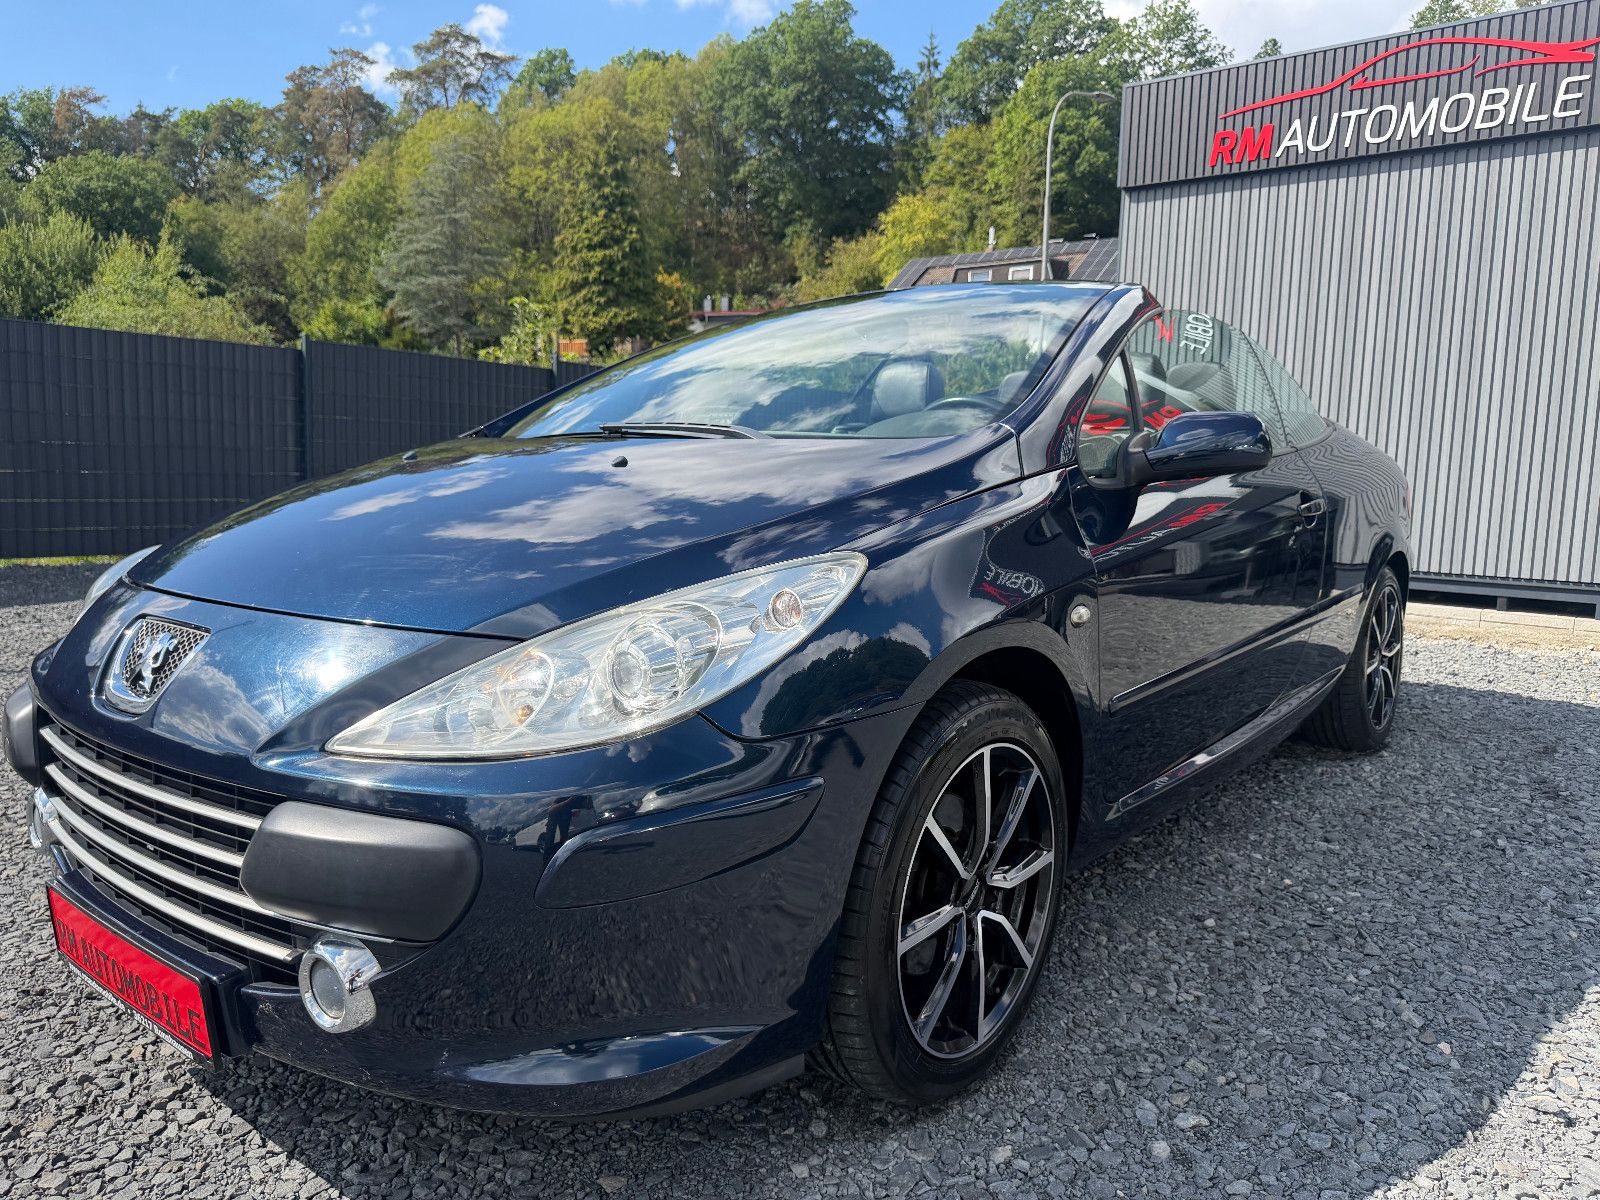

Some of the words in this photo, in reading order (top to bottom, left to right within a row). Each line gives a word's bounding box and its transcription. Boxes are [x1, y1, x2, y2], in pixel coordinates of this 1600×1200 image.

[1209, 124, 1274, 167] RM
[1275, 75, 1591, 159] AUTOMOBILE
[57, 918, 78, 959] RM
[81, 936, 206, 1049] AUTOMOBILE
